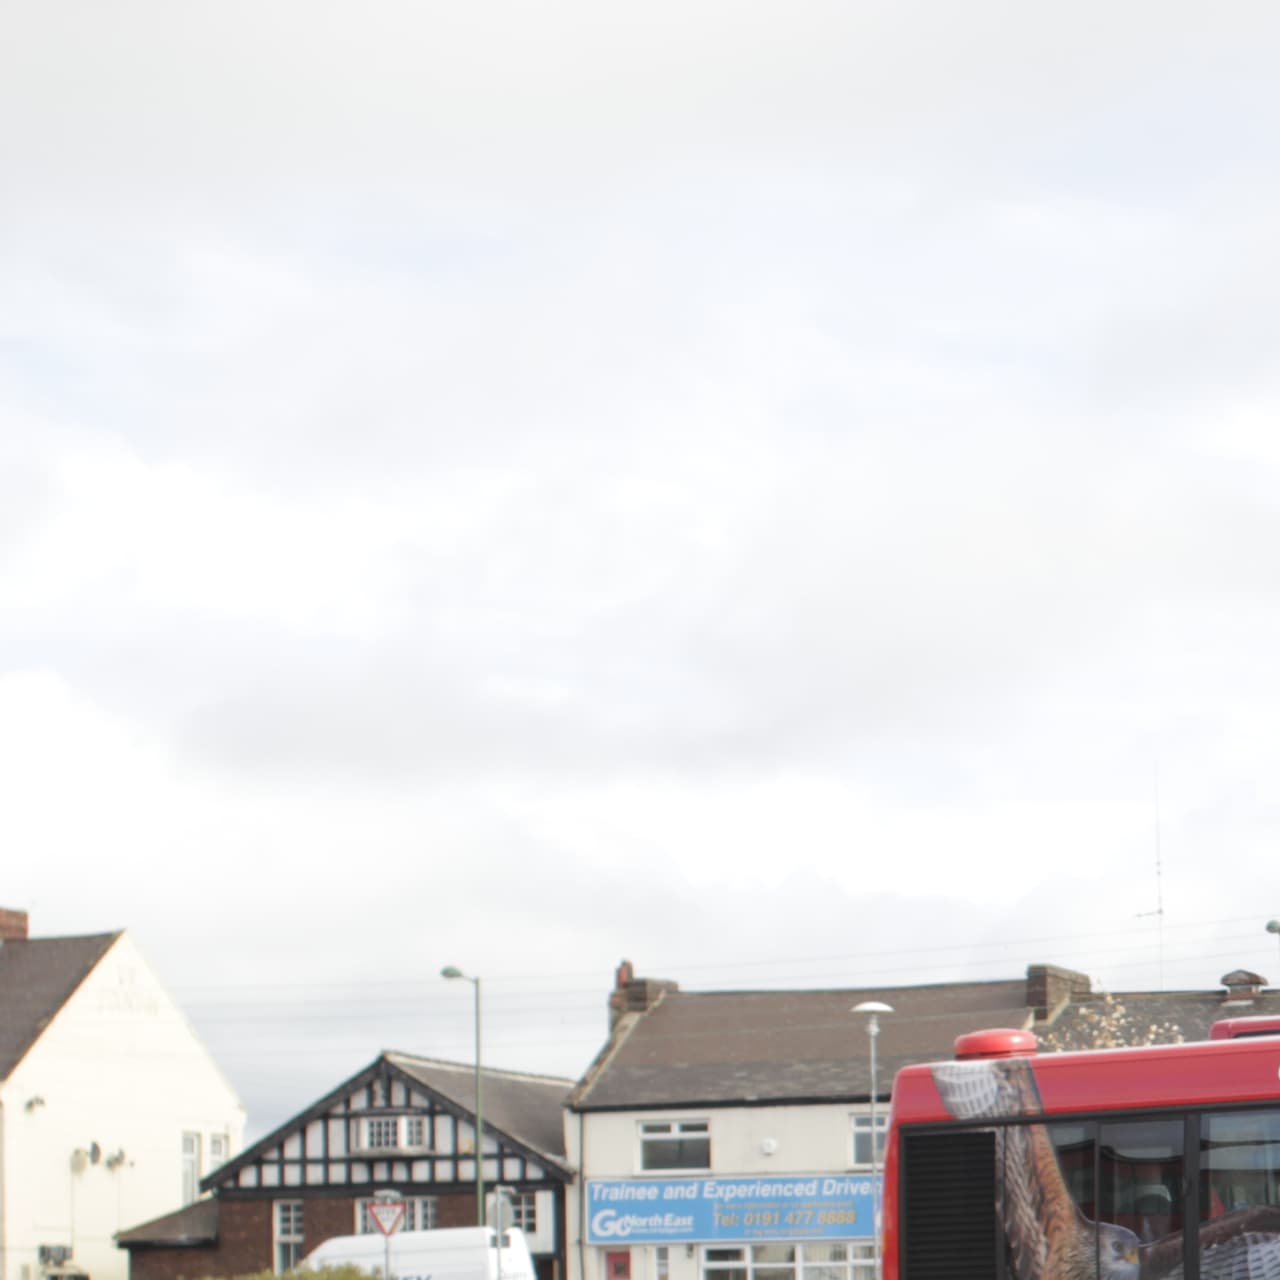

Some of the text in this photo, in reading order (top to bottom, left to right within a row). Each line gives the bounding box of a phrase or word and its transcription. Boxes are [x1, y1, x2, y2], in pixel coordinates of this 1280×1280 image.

[592, 1184, 658, 1201] Trainee
[663, 1181, 698, 1199] and
[703, 1179, 817, 1202] Experienced
[592, 1209, 632, 1237] Go
[624, 1214, 662, 1227] North
[663, 1213, 694, 1227] East
